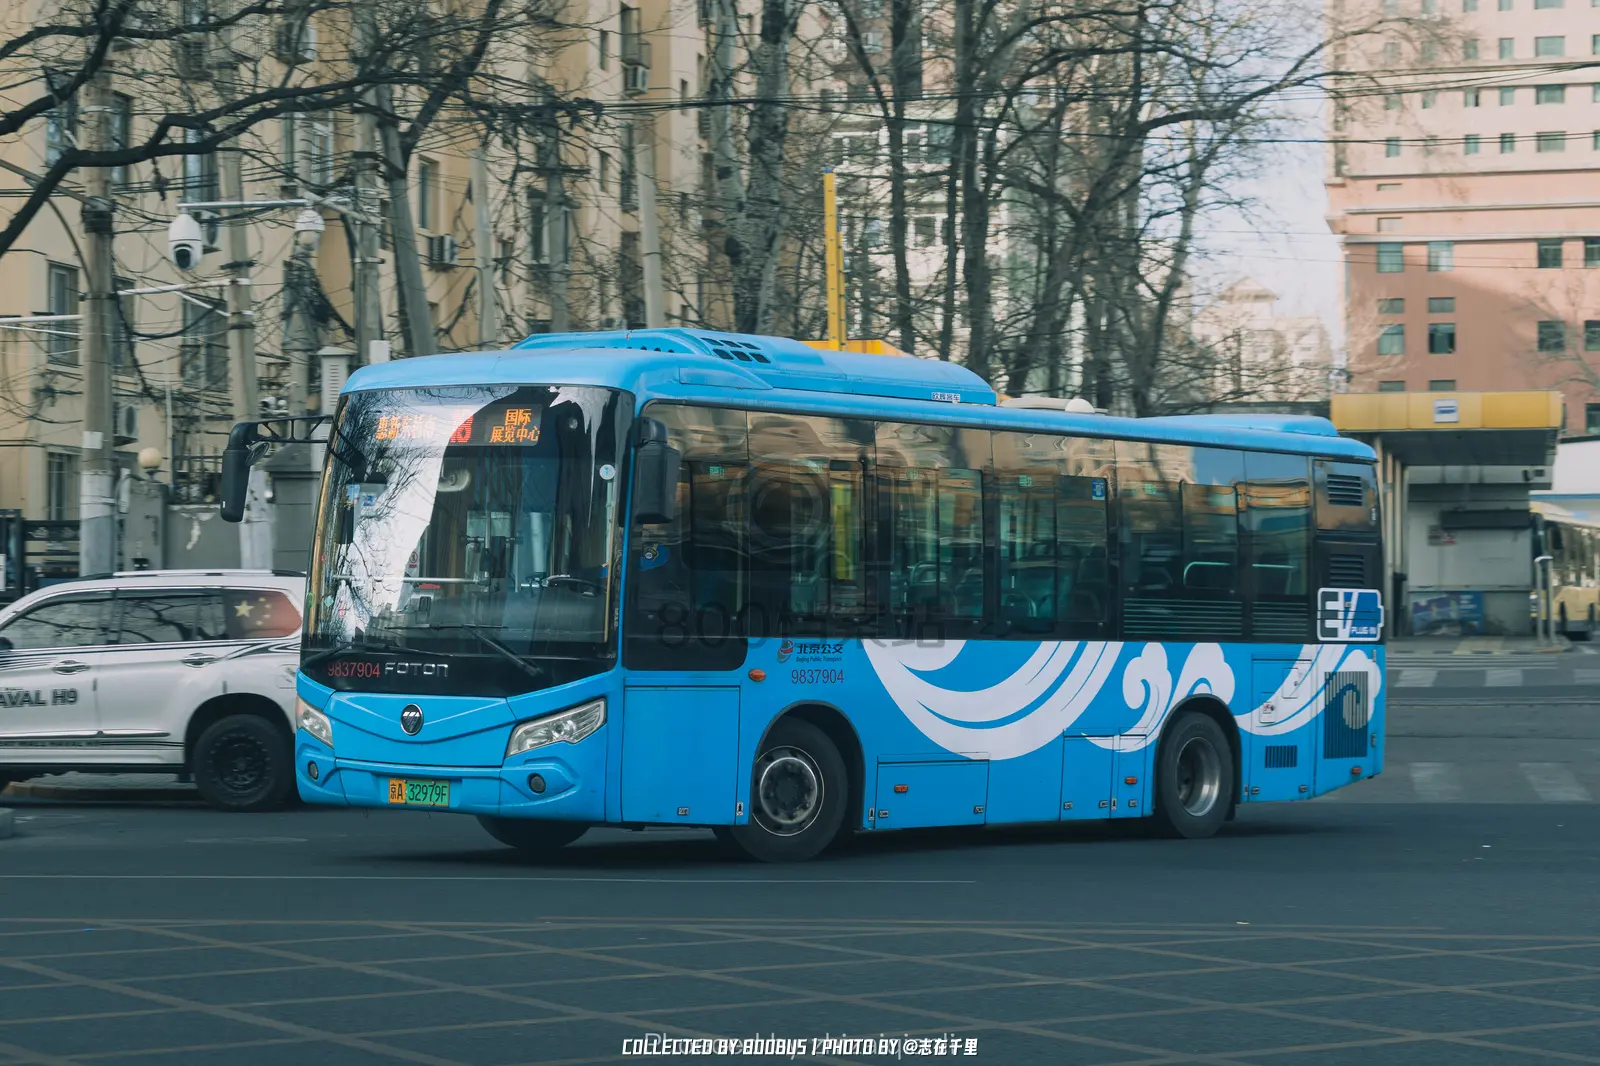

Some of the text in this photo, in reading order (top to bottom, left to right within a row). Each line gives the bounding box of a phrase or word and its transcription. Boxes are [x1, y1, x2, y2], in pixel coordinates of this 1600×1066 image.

[504, 408, 532, 426] 国际
[490, 425, 541, 443] 展览中心
[796, 643, 844, 654] 北京公交
[327, 662, 381, 678] 9837904
[385, 662, 449, 678] FOTON
[791, 669, 845, 684] 9837904
[51, 688, 78, 706] H9
